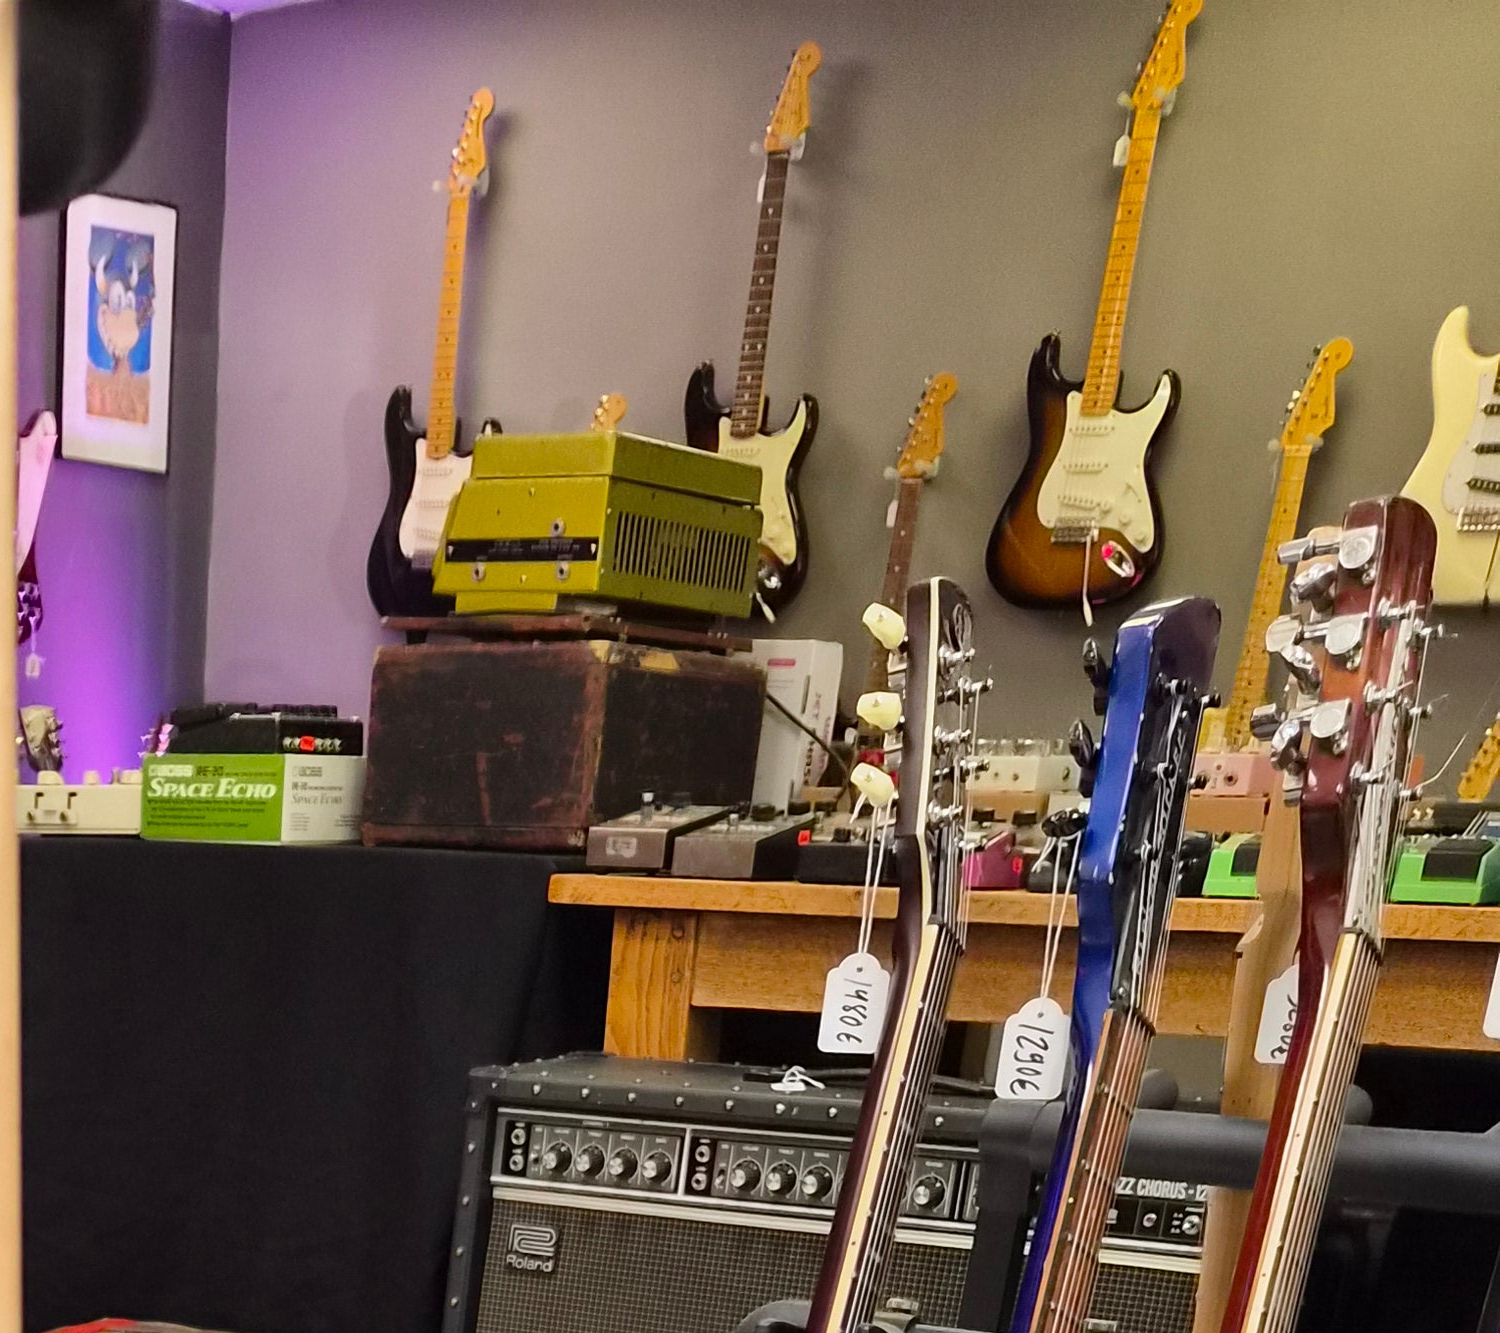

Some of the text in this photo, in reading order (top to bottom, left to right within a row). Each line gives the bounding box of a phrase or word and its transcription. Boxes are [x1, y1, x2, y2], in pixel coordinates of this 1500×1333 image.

[147, 778, 214, 798] SPACE
[215, 778, 277, 798] ECHO
[1009, 1023, 1055, 1096] 1290€
[506, 1254, 556, 1273] Roland
